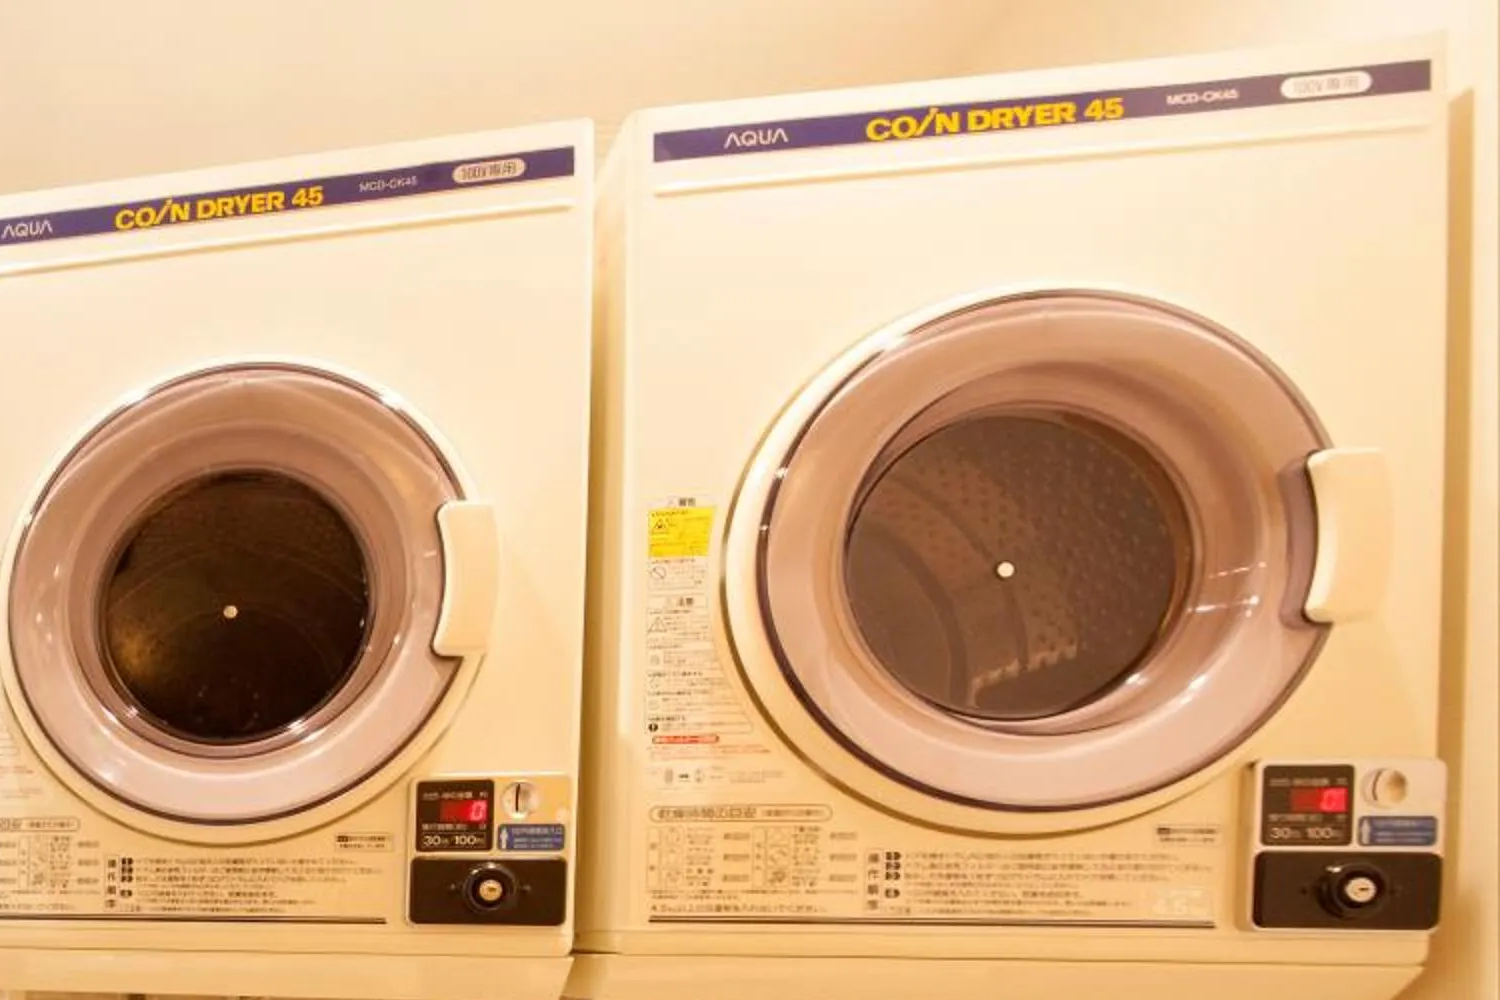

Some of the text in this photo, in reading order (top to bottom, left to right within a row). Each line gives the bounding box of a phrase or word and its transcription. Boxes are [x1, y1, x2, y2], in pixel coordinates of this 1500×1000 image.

[725, 127, 789, 148] AQUA
[967, 102, 1078, 134] DRYER
[1084, 97, 1124, 122] 45
[1, 220, 53, 239] AQUA
[196, 191, 286, 220] DRYER
[291, 186, 324, 208] 45
[470, 801, 487, 821] 0
